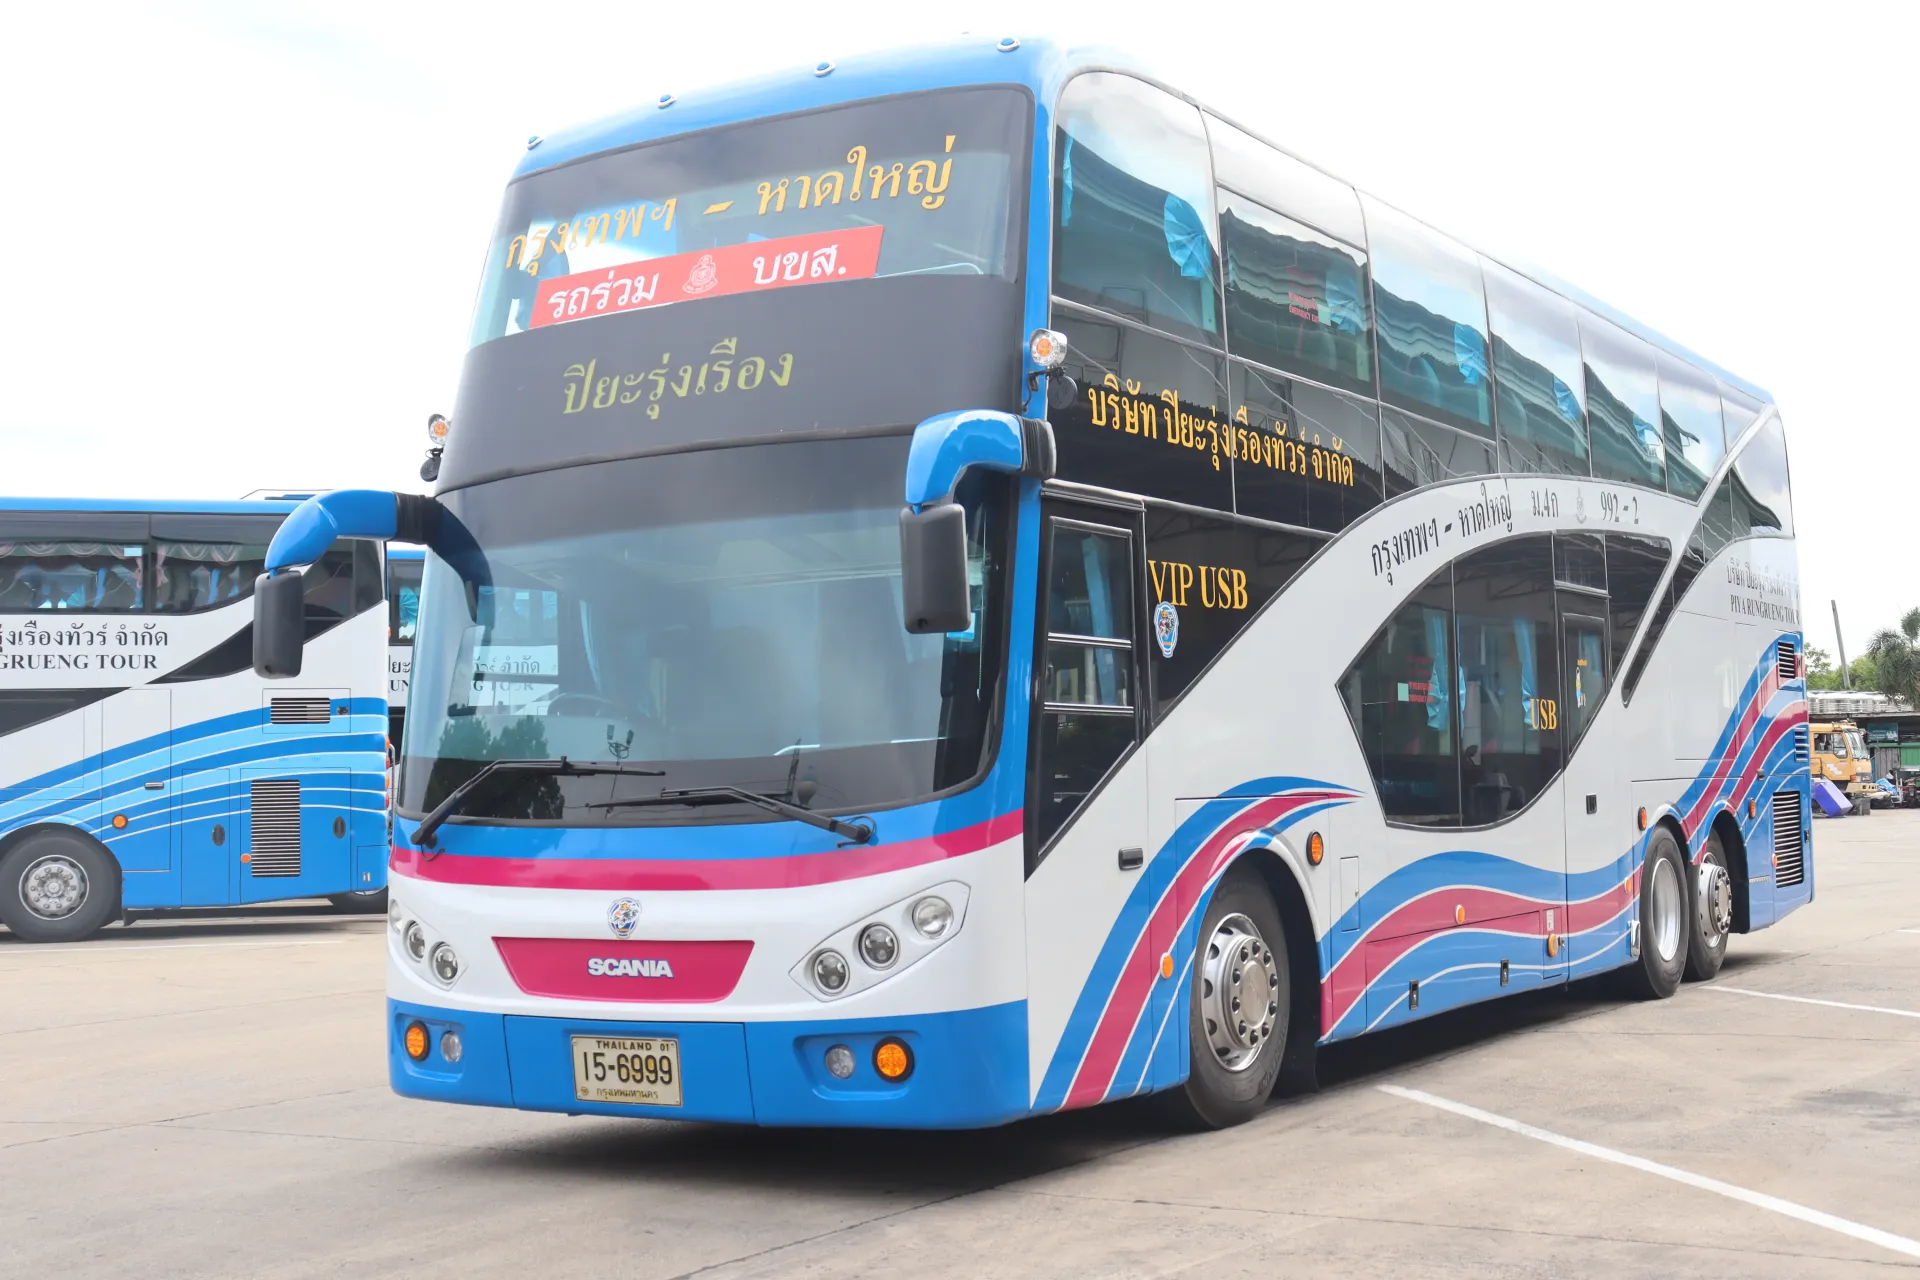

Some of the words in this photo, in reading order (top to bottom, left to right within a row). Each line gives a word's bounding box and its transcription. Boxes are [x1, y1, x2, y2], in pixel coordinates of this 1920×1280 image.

[505, 197, 677, 276] กรุงเทพฯ
[757, 135, 956, 216] หาดใหญ่
[548, 269, 660, 319] รถร่วม
[752, 243, 847, 285] บขส.
[562, 337, 794, 420] ปิยะรุ่งเรือง
[1088, 373, 1157, 439] บริษัท
[1161, 389, 1307, 475] ปิยะรุ่งเรืองทัวร์
[1312, 433, 1354, 487] จำกัด
[1371, 518, 1439, 586] กรุงเทพฯ
[1458, 478, 1513, 533] หาดใหญ่
[1148, 560, 1193, 607] VIP
[1198, 565, 1248, 609] USB
[116, 623, 168, 646] จำกัด
[96, 654, 158, 670] TOUR
[1529, 698, 1557, 730] USB
[587, 957, 674, 978] SCANIA
[596, 1040, 652, 1051] THAILAND
[583, 1052, 673, 1085] 15-6999
